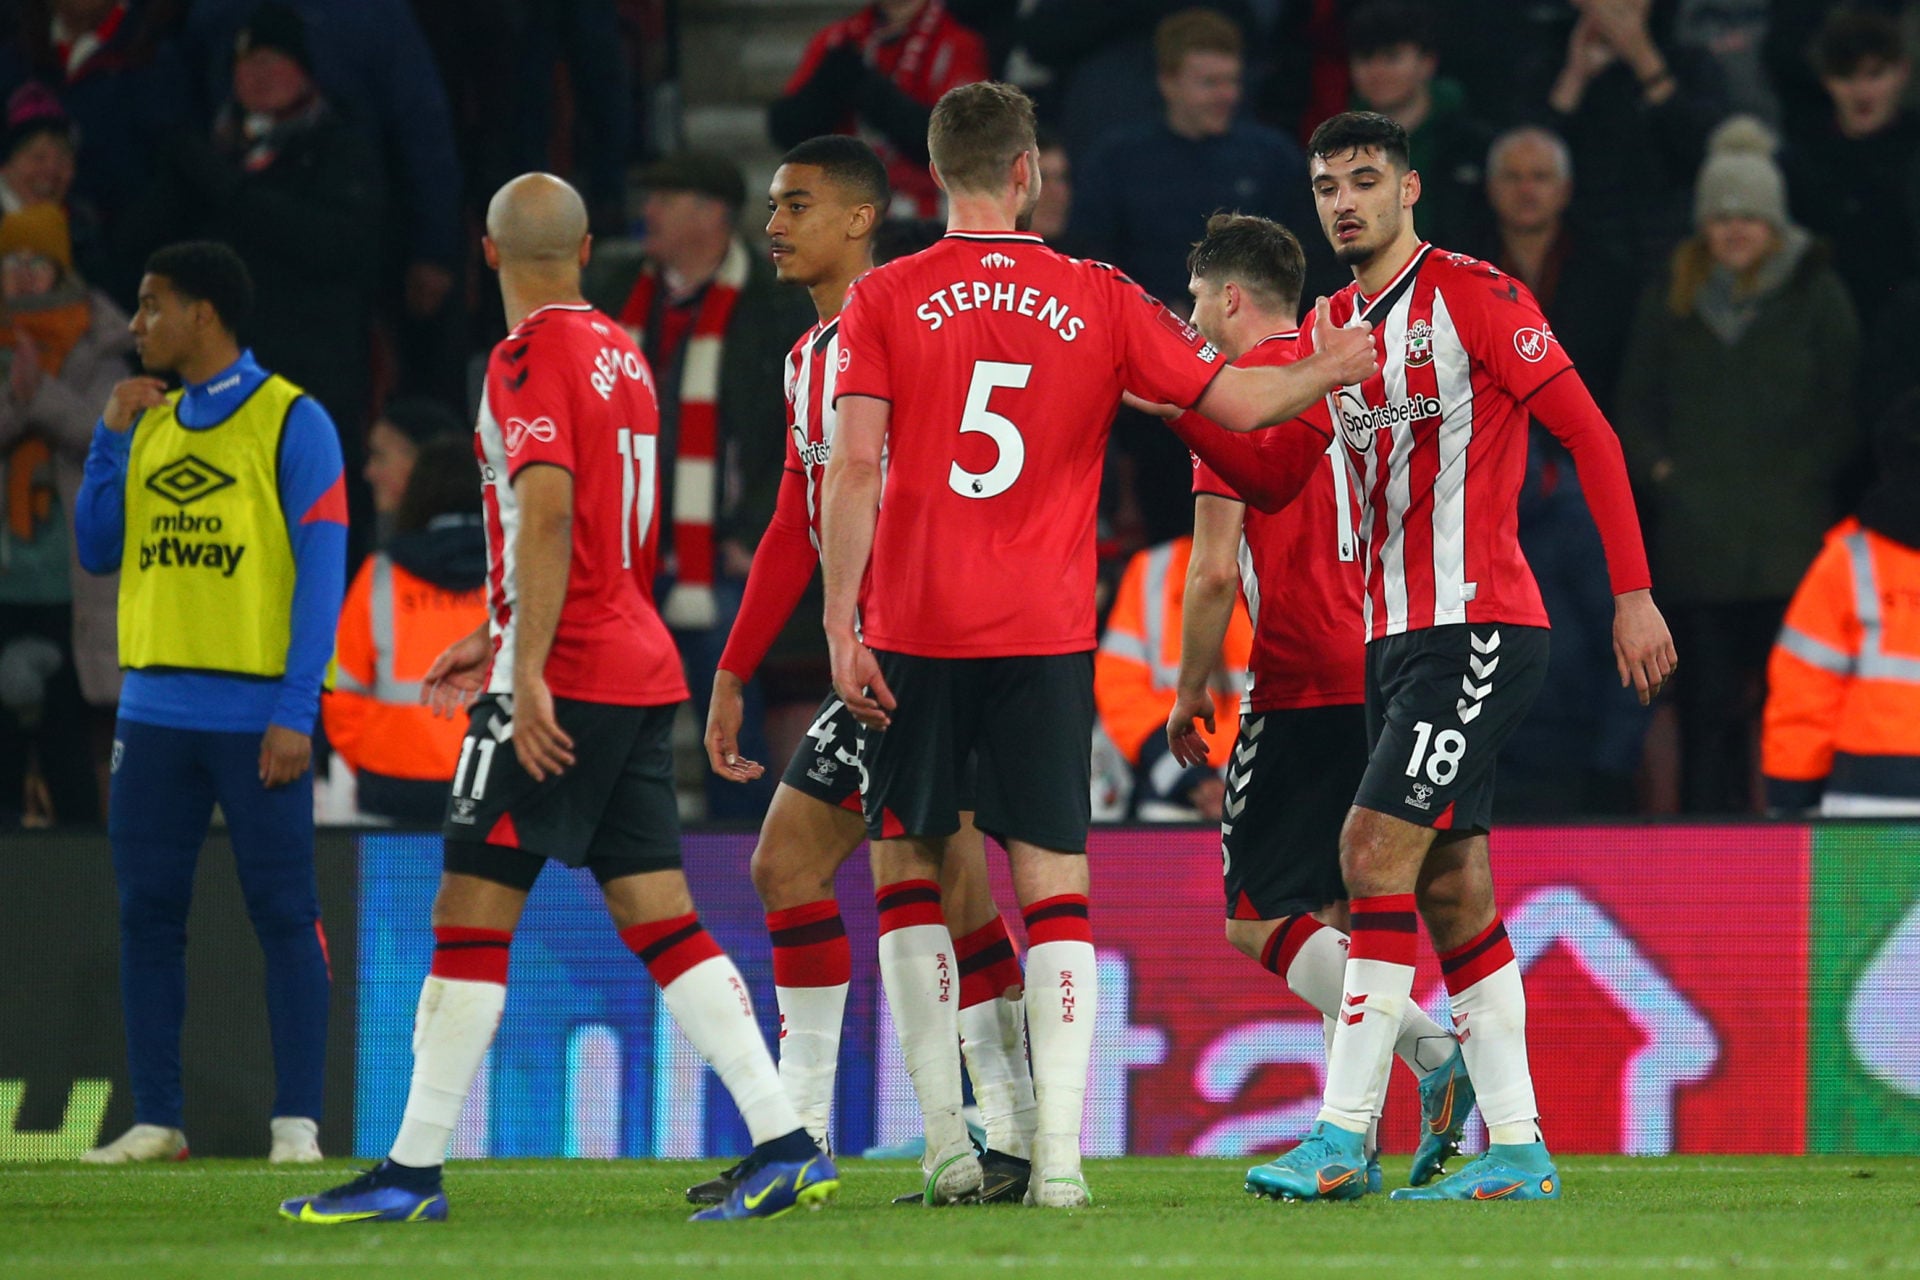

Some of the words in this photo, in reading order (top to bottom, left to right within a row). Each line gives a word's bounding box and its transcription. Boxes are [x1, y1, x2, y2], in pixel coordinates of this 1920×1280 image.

[916, 282, 1086, 342] STEPHENS
[948, 360, 1032, 499] 5
[1342, 394, 1441, 437] Sportsbet.io
[152, 509, 223, 534] mbro
[617, 427, 657, 570] 11
[452, 735, 497, 801] 11
[1405, 720, 1467, 786] 18
[936, 953, 951, 1003] SAINTS
[1059, 970, 1075, 1023] SAINTS
